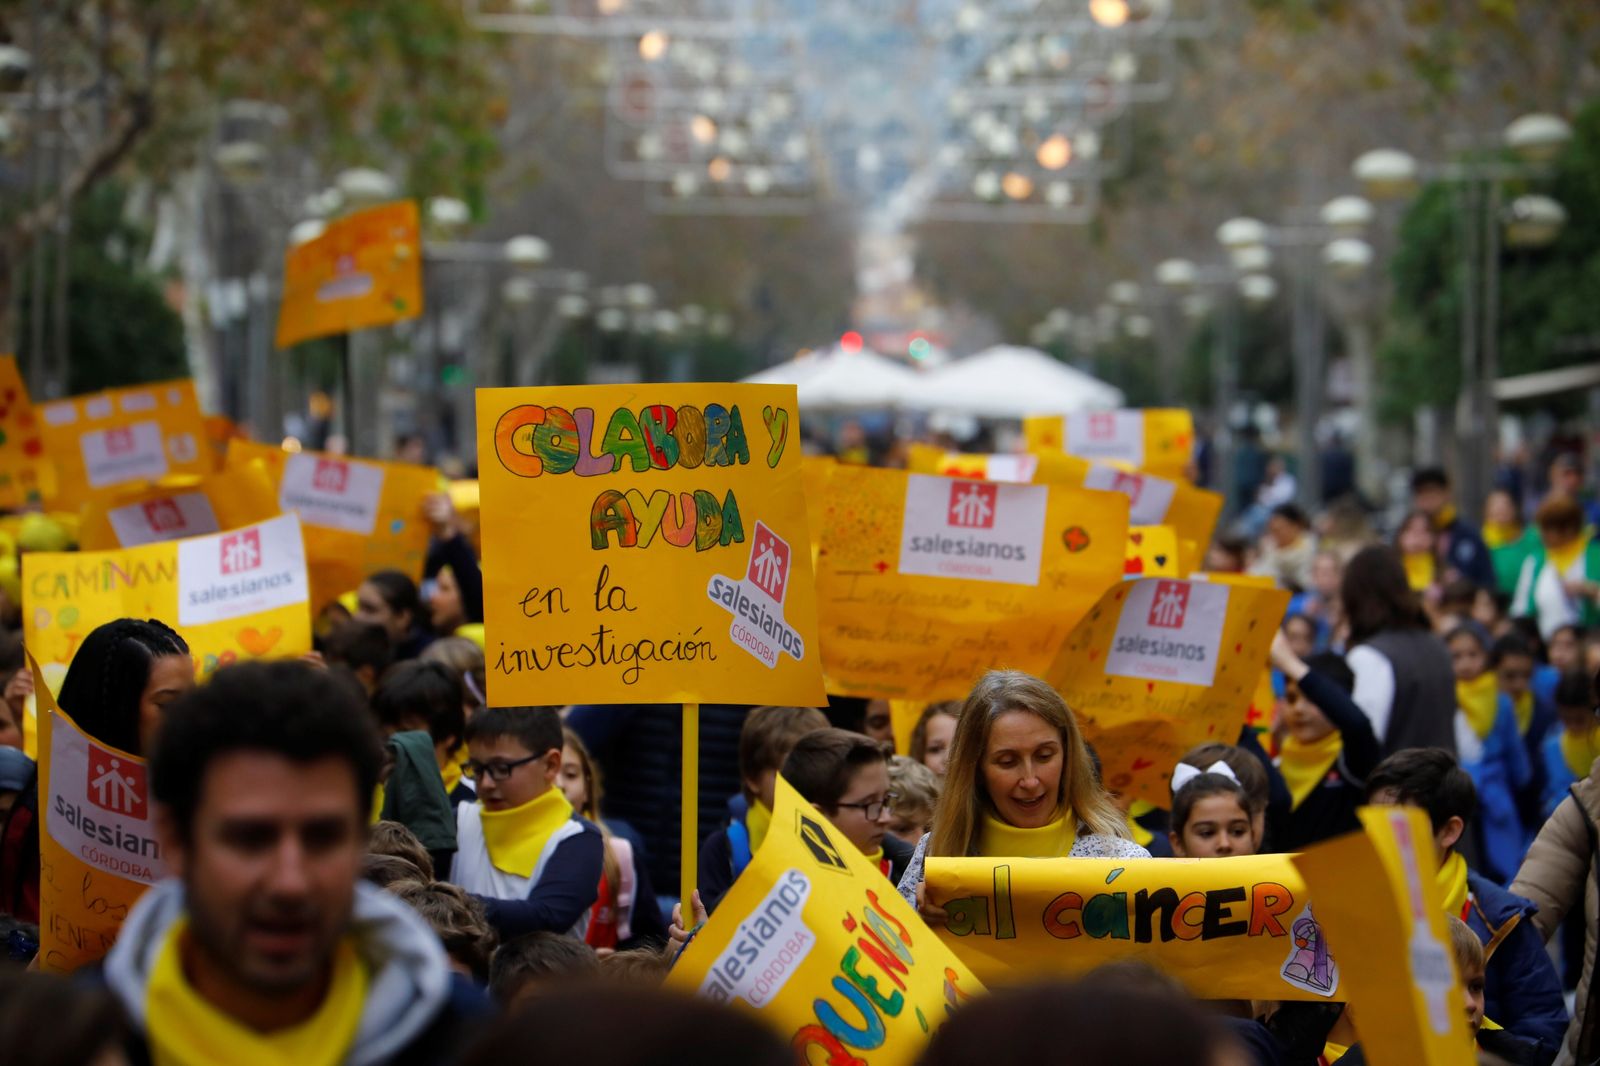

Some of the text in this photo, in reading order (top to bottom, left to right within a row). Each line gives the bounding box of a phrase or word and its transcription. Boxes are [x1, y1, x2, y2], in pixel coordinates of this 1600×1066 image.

[494, 403, 788, 477] COLABORA Y
[590, 488, 745, 552] AYUDA
[909, 533, 1026, 562] salesianos
[188, 570, 293, 606] salesianos
[519, 565, 637, 617] en la
[709, 578, 802, 661] salesianos
[495, 624, 717, 685] investigación
[731, 623, 776, 666] CÓRDOBA
[1114, 635, 1206, 662] salesianos
[54, 793, 160, 860] salesian
[80, 843, 153, 881] CÓRDOBA
[942, 864, 1016, 939] al
[705, 871, 807, 1002] alesianos
[748, 930, 808, 1004] CÓRDOBA
[792, 888, 914, 1066] QUEÑOS
